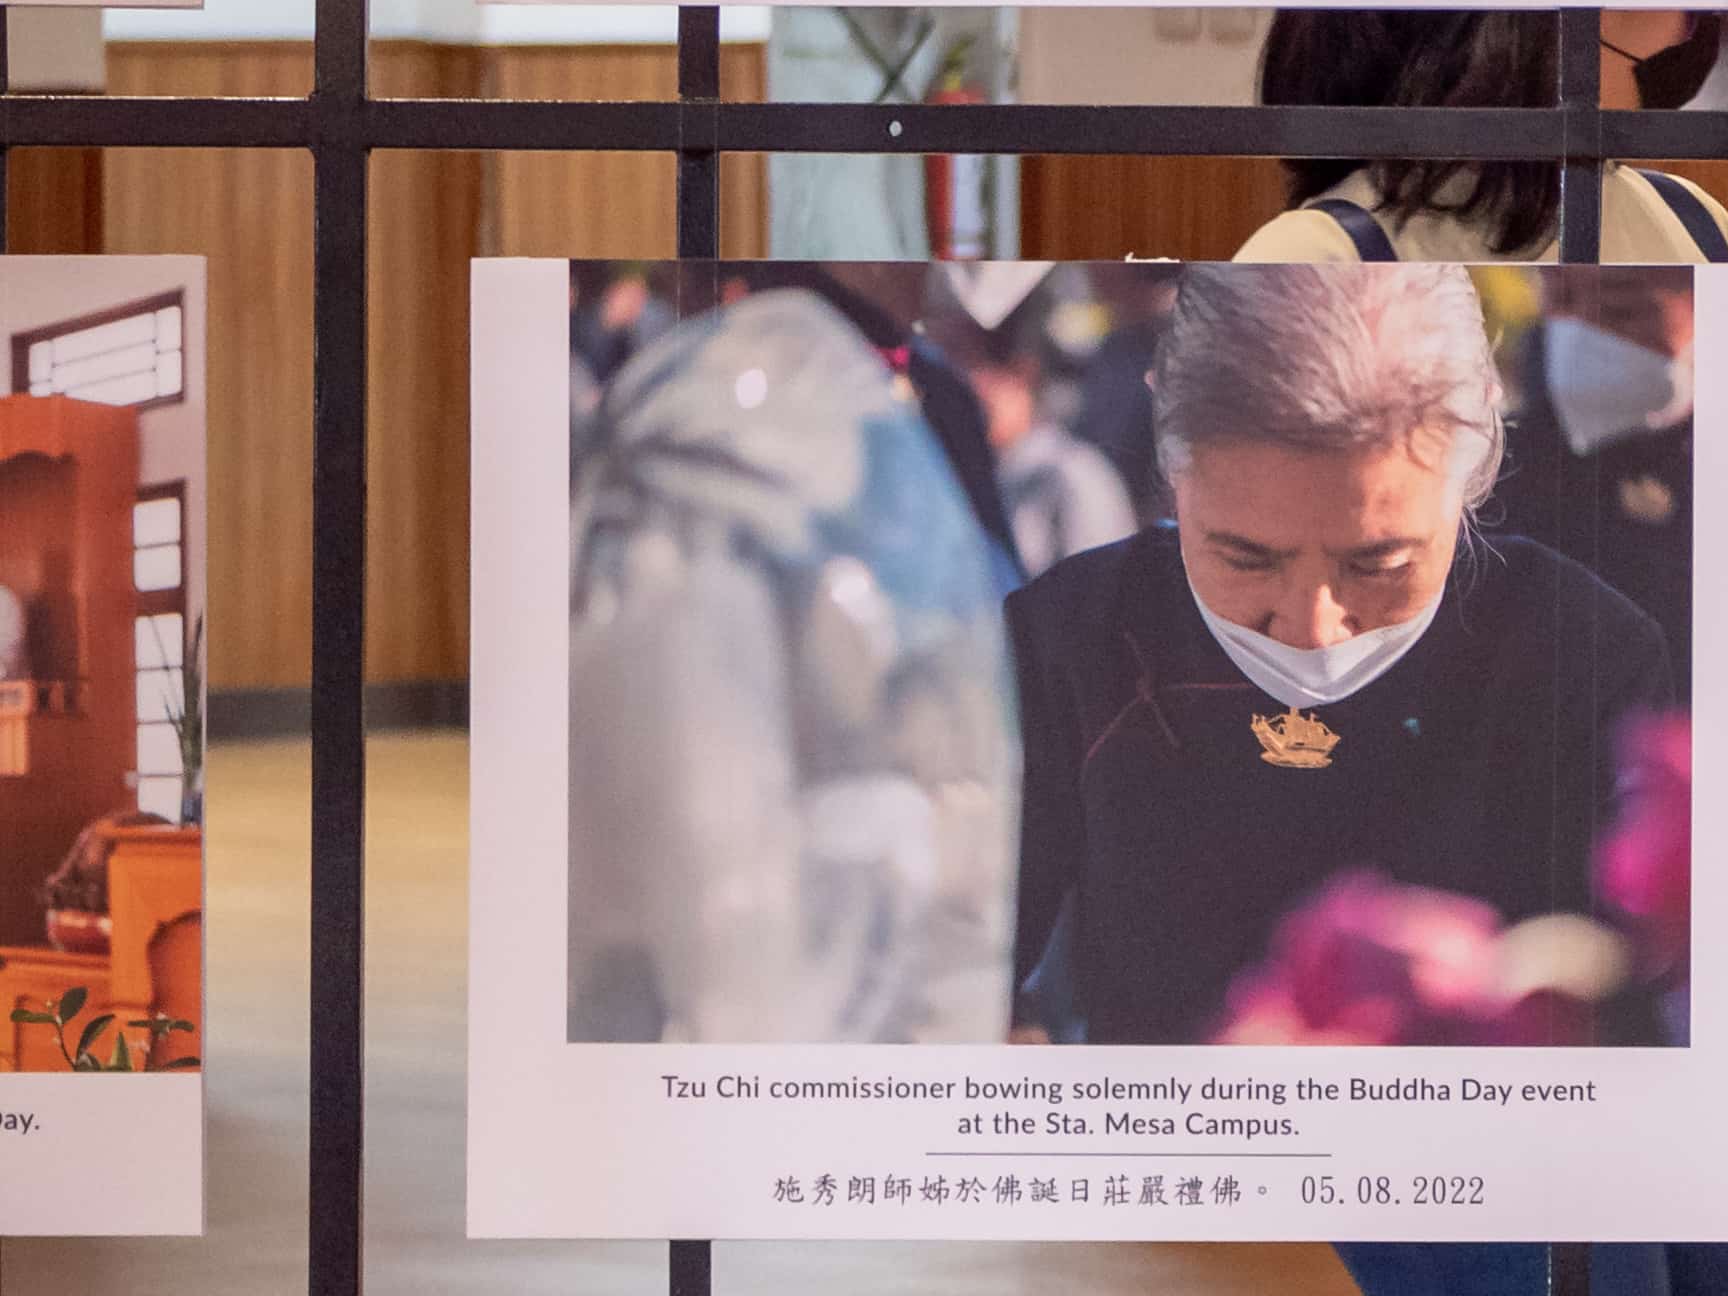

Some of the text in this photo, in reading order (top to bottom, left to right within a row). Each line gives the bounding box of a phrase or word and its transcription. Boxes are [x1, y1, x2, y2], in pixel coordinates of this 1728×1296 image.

[660, 1075, 1597, 1107] Tzu Chi commissioner bowing solemnly during the Buddha Day event
[957, 1111, 1300, 1141] at the Sta. Mesa Campus.
[773, 1173, 1485, 1207] 施秀朗師姊於佛誕日莊嚴禮佛。 05.08.2022
